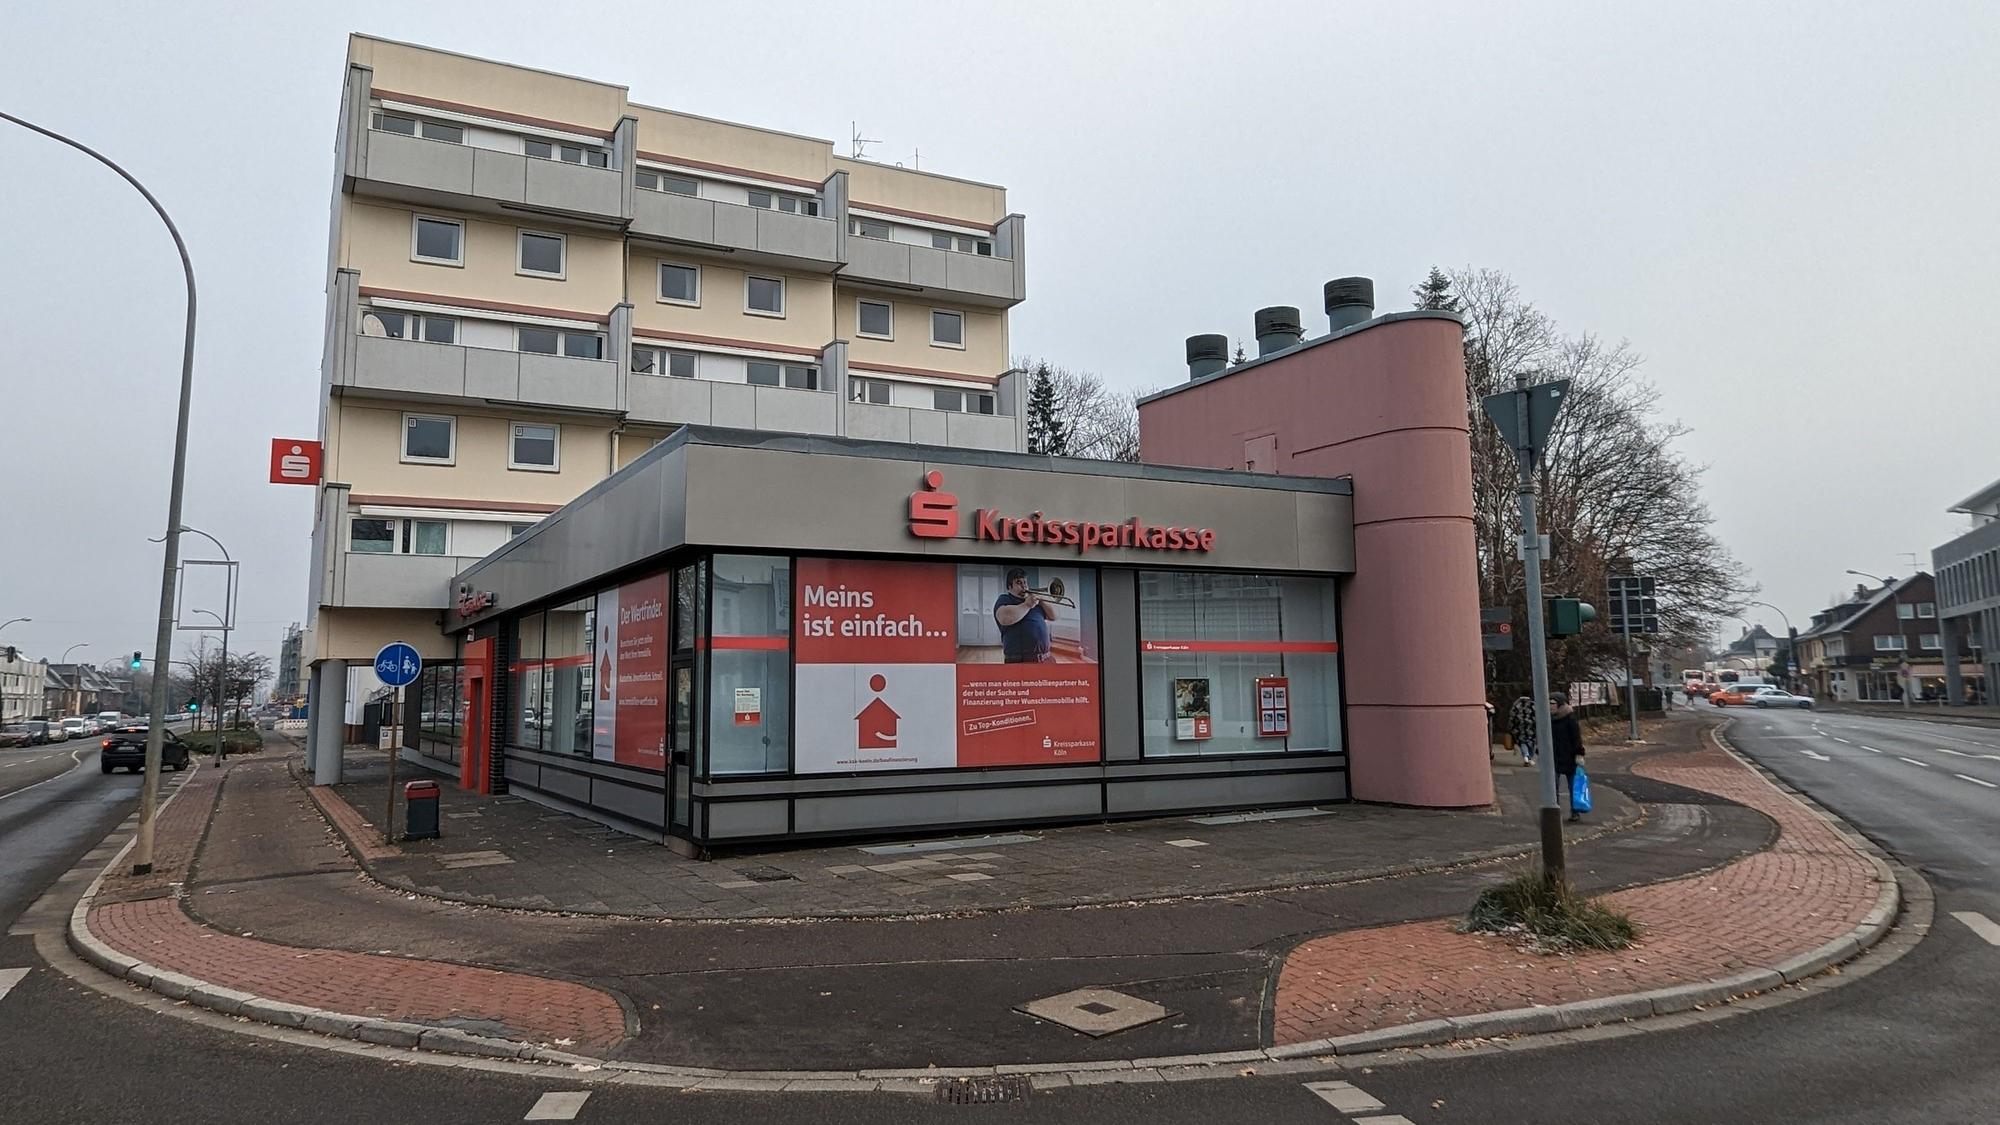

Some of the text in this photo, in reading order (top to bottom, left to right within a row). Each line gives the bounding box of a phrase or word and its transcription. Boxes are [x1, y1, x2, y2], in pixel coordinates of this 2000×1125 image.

[975, 508, 1217, 555] Kreissparkasse
[804, 584, 873, 608] Meins
[620, 608, 630, 624] Der
[803, 614, 834, 637] ist
[1021, 679, 1077, 688] Immobilienpartner
[997, 689, 1016, 697] Suche
[962, 698, 1004, 707] Finanzierung
[1021, 697, 1075, 705] Wunschimmobilie
[968, 722, 978, 731] Zu
[1053, 740, 1096, 749] Kreissparkasse
[1053, 748, 1068, 756] Köln
